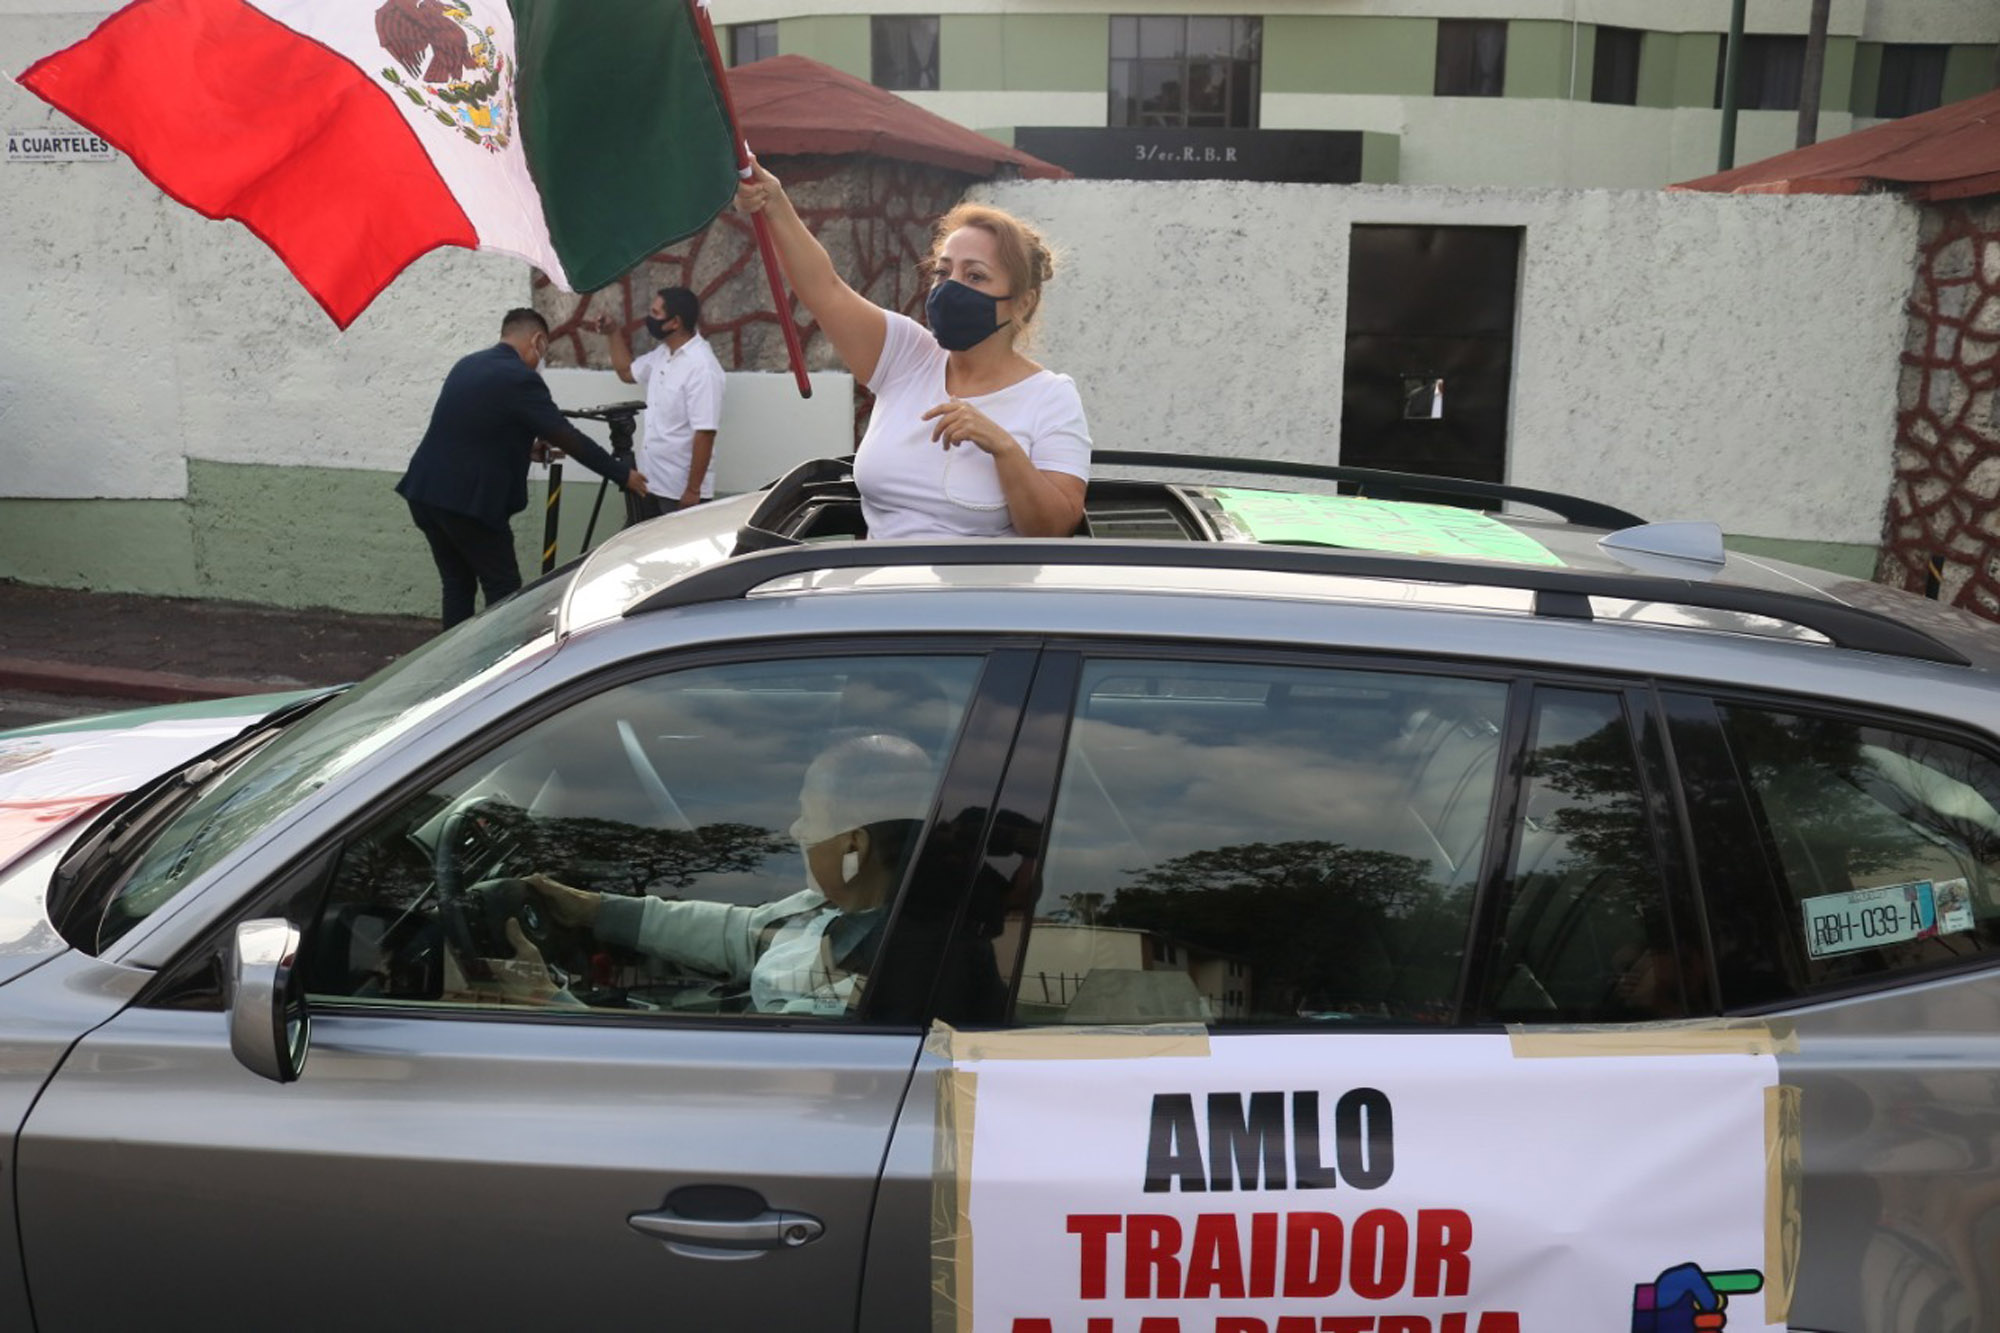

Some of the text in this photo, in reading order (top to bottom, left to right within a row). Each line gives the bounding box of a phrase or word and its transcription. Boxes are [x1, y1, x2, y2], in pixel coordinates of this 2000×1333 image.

[9, 138, 108, 152] A CUARTELES
[1813, 902, 1922, 946] RBH-039-A
[1144, 1087, 1394, 1193] AMLO
[1066, 1209, 1473, 1300] TRAIDOR
